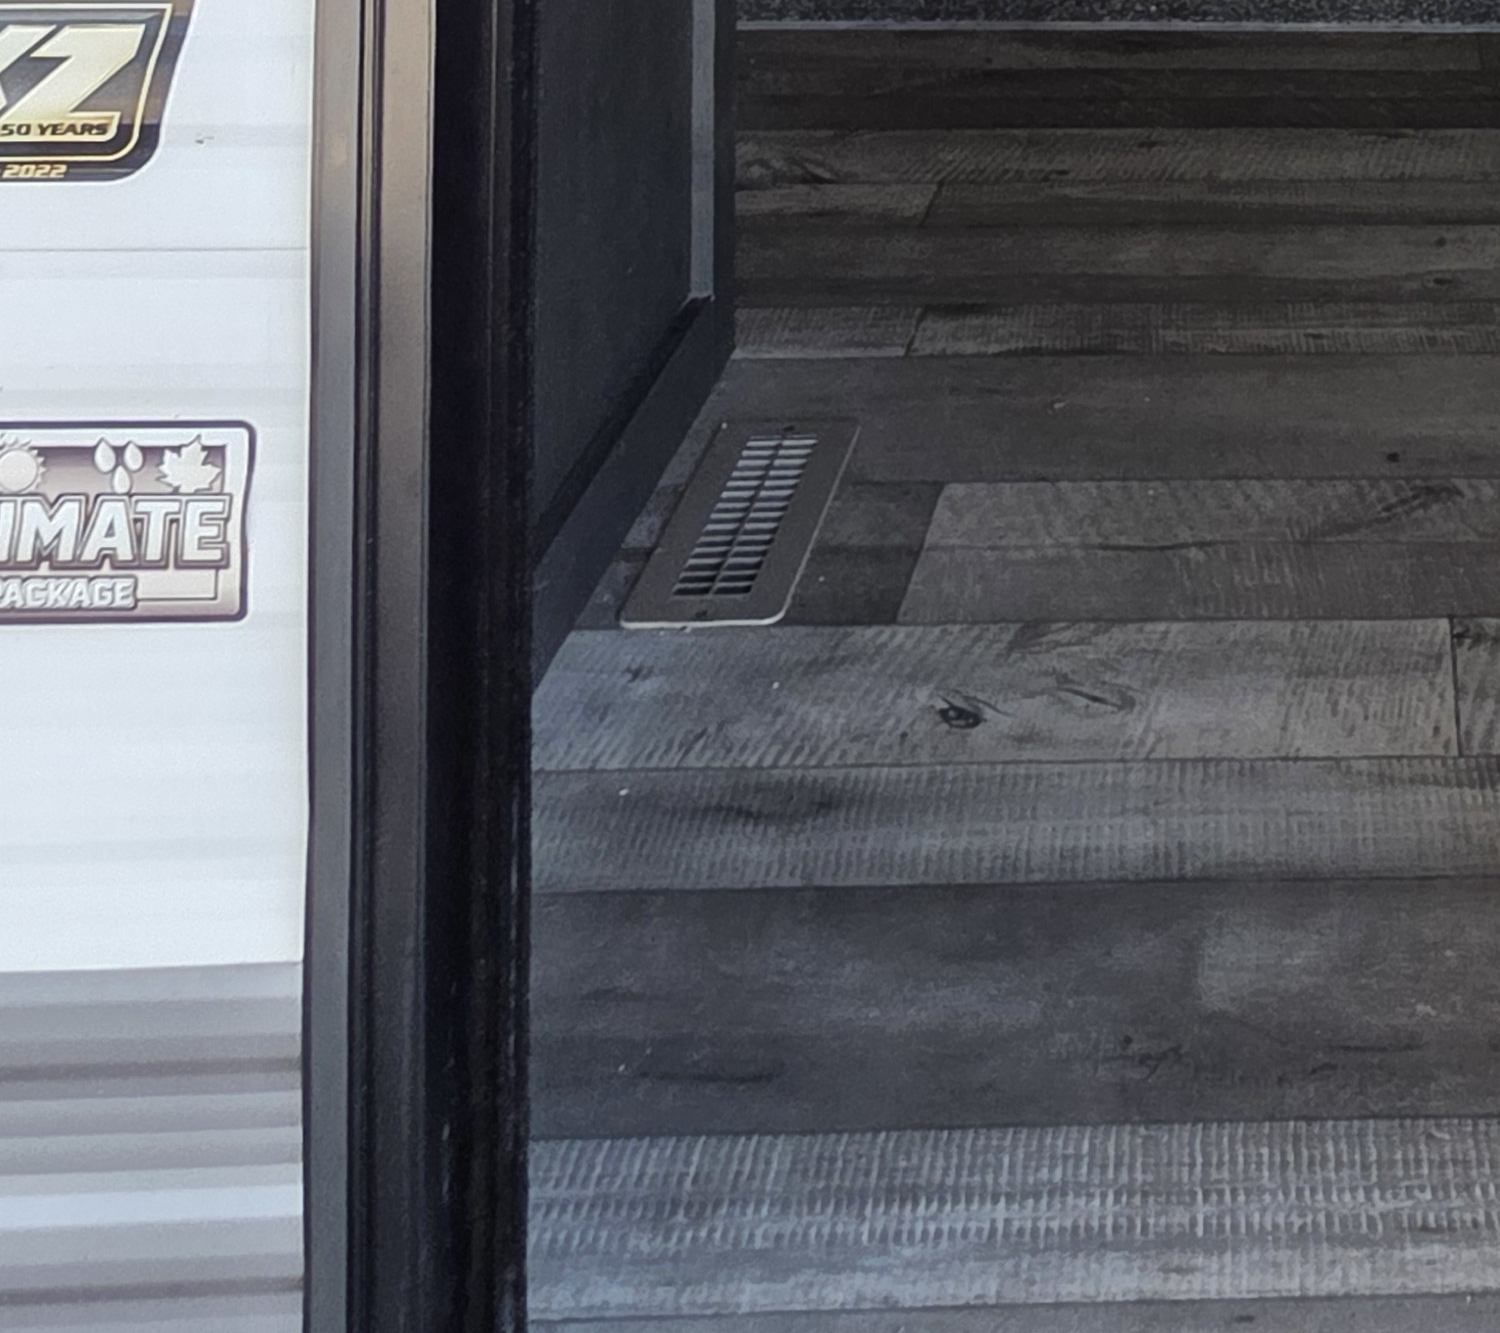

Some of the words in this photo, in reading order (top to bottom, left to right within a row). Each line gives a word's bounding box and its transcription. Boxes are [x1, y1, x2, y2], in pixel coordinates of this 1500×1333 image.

[1, 123, 31, 136] 50
[37, 123, 108, 136] YEARS
[2, 164, 67, 179] 2022
[0, 580, 135, 609] ACKAGE
